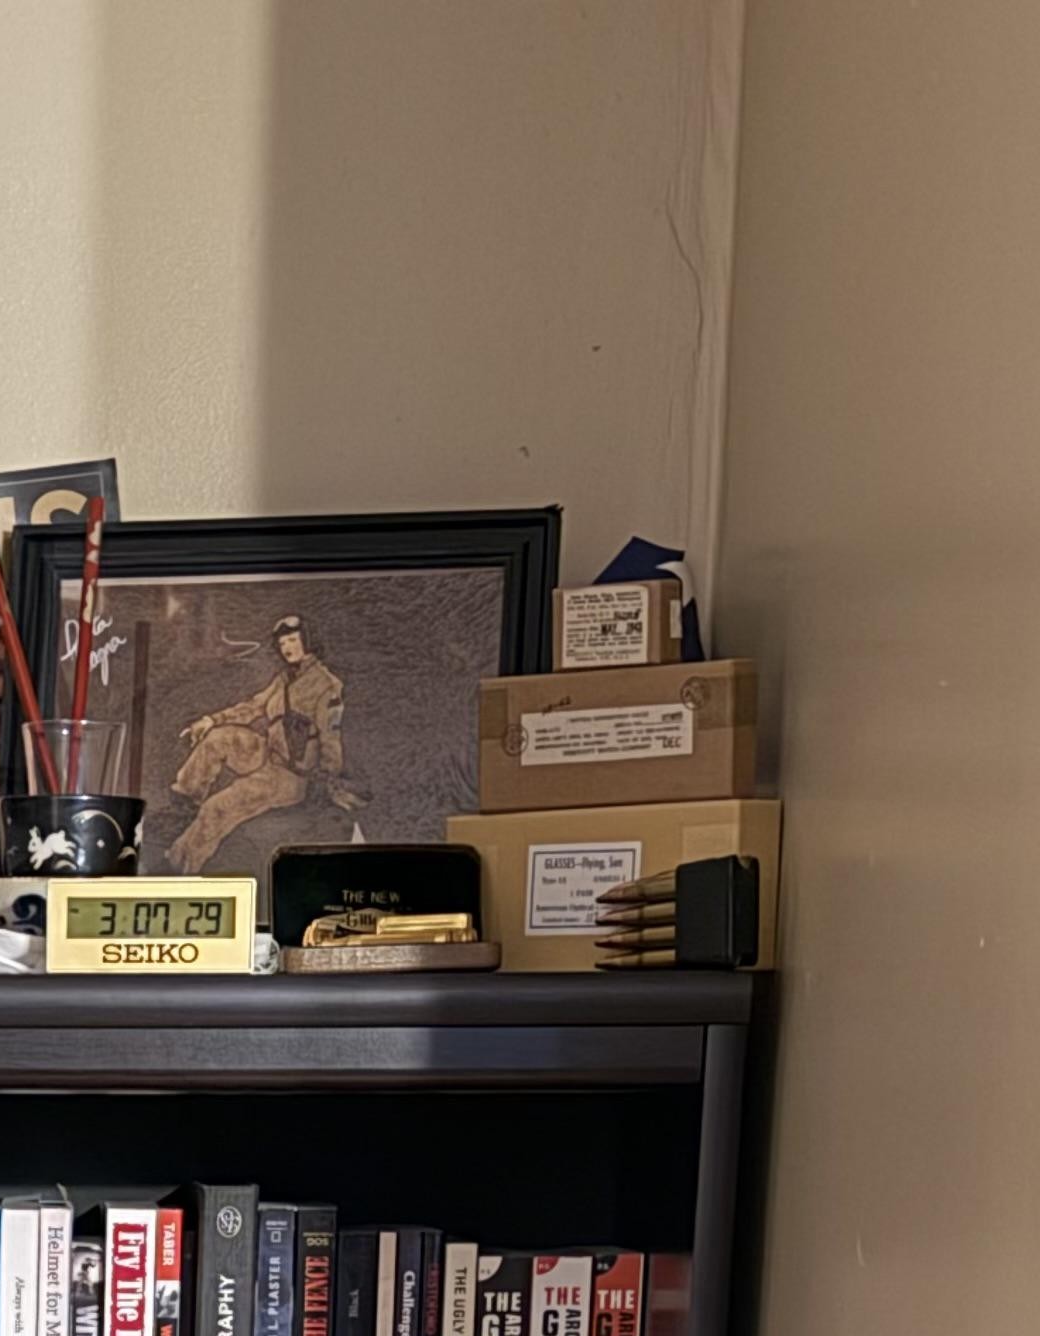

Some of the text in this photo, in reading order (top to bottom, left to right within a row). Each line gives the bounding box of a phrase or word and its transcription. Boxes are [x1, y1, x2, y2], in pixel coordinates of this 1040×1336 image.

[371, 890, 400, 903] NEW
[102, 943, 198, 964] SEIKO
[47, 1224, 64, 1291] Helmet
[118, 1223, 146, 1263] Fry
[116, 1268, 145, 1321] The
[304, 1256, 329, 1312] FENCE
[453, 1297, 467, 1333] UGLY
